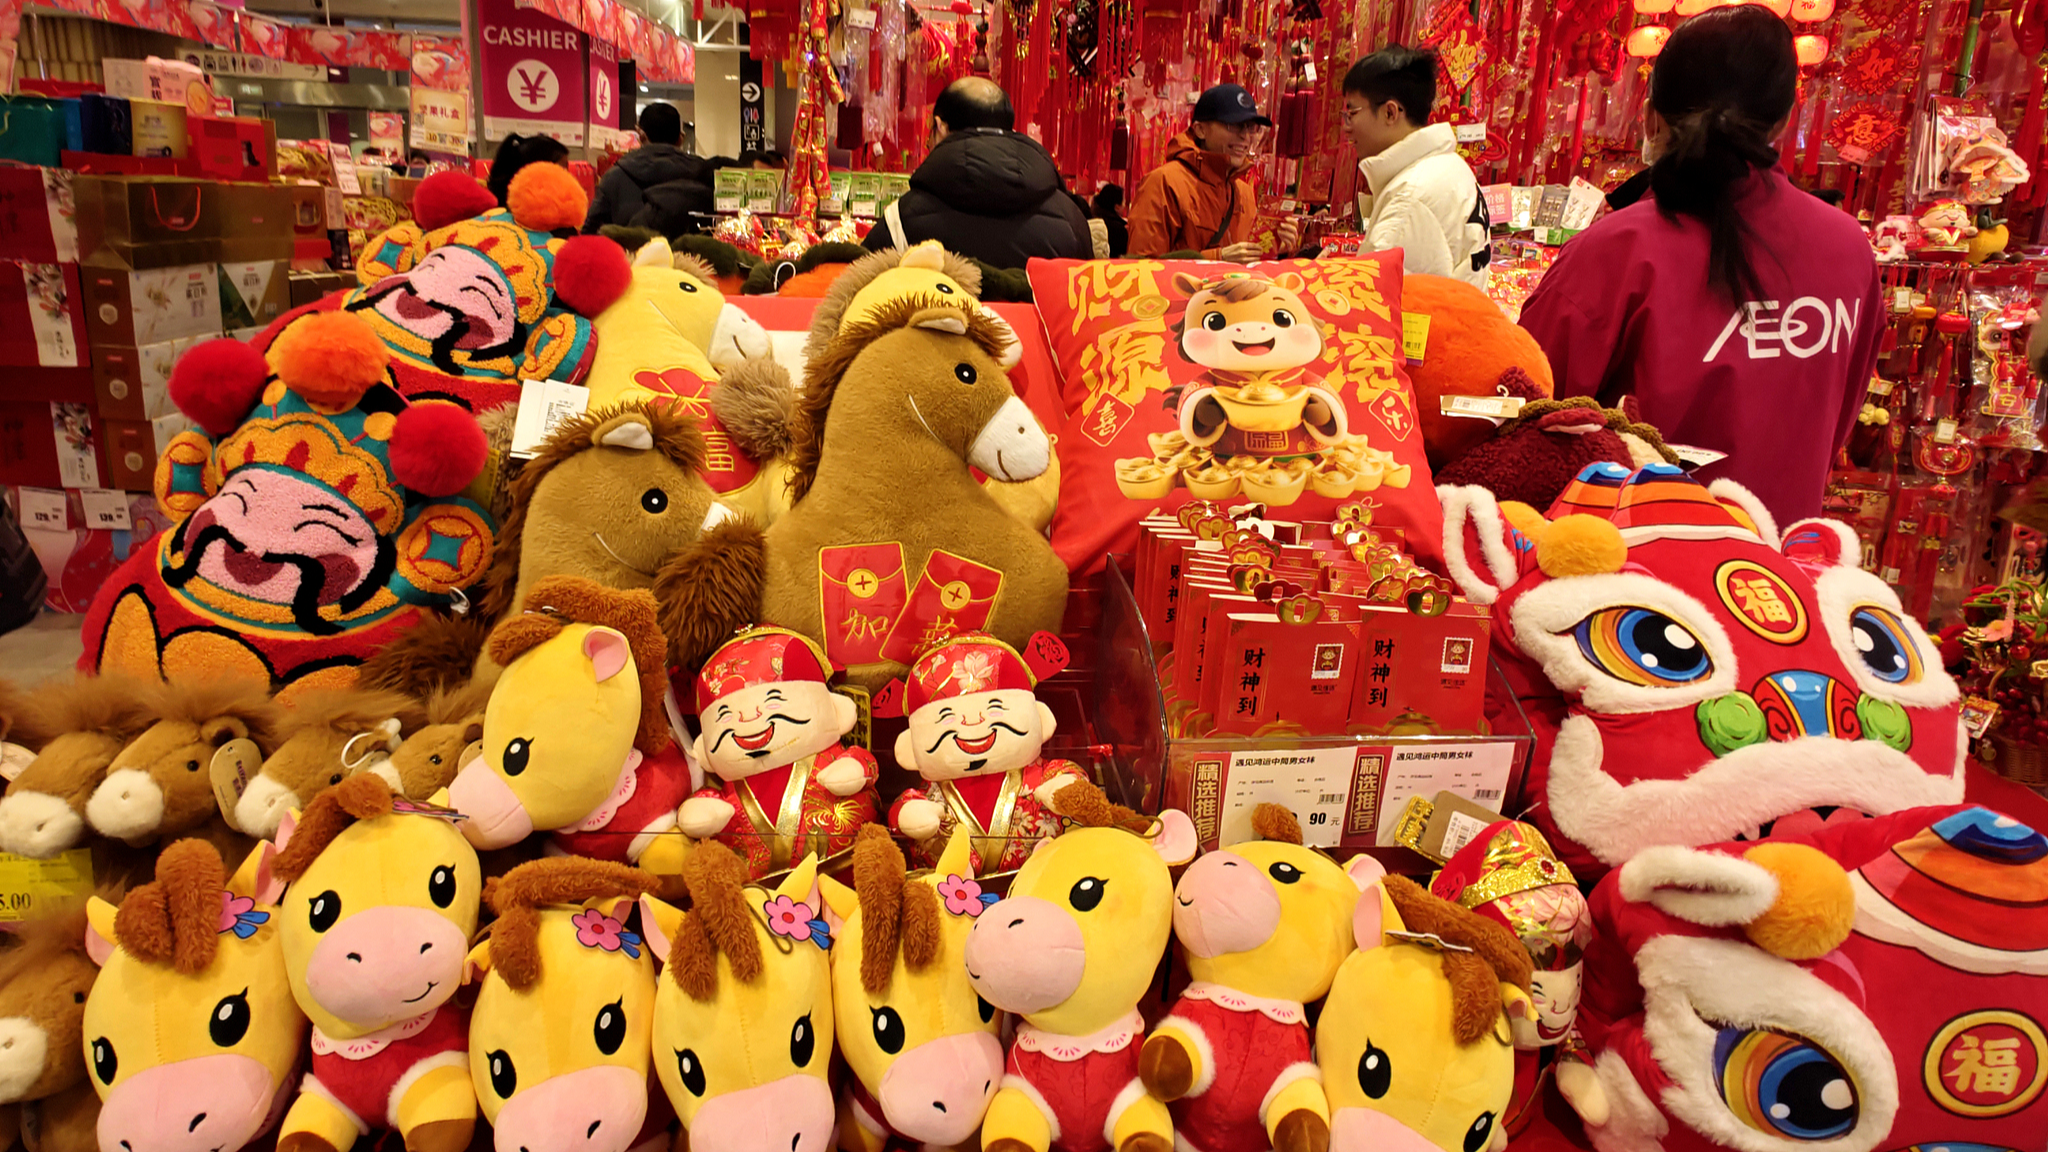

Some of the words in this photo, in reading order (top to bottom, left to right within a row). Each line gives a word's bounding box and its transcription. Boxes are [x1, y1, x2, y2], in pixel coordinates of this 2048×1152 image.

[483, 24, 578, 51] CASHIER
[1092, 400, 1119, 437] 喜
[840, 606, 889, 643] 加
[1730, 577, 1792, 624] 福
[1236, 647, 1266, 717] 财神到
[1368, 637, 1396, 709] 财神到
[1195, 763, 1219, 841] 精选推荐
[1309, 811, 1327, 825] 90
[1353, 757, 1381, 831] 精选推荐
[1943, 1033, 2022, 1096] 福
